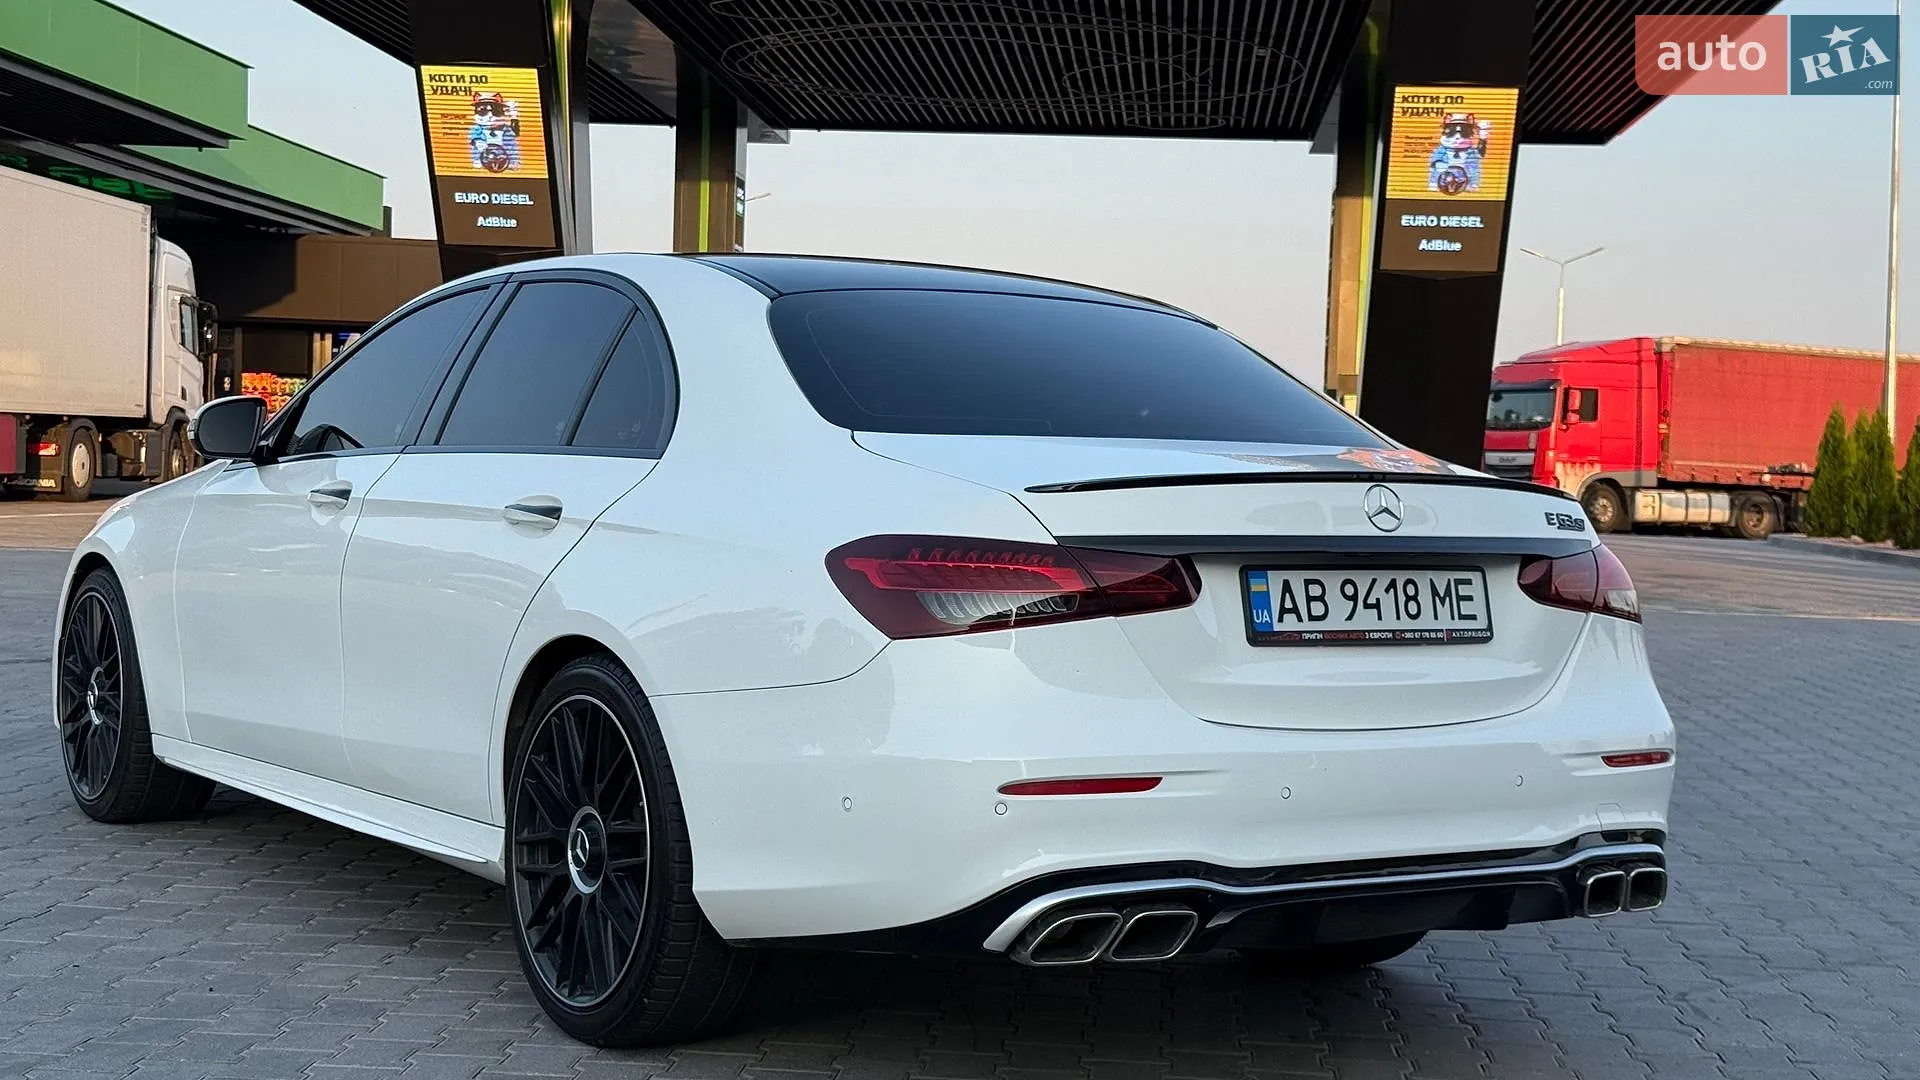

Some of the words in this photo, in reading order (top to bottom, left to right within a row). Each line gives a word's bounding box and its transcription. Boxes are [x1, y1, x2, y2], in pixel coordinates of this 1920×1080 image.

[429, 73, 466, 84] КОТИ
[469, 74, 489, 85] ДО
[1401, 95, 1441, 105] КОТИ
[1442, 96, 1464, 105] ДО
[454, 192, 489, 204] EURO
[491, 193, 534, 205] DIESEL
[477, 216, 518, 228] AdBlue
[1401, 215, 1438, 227] EURO
[1440, 216, 1484, 228] DIESEL
[1418, 239, 1462, 252] AdBlue
[1277, 578, 1330, 624] AB
[1339, 577, 1422, 622] 9418
[1429, 577, 1478, 622] ME
[1253, 610, 1271, 624] UA
